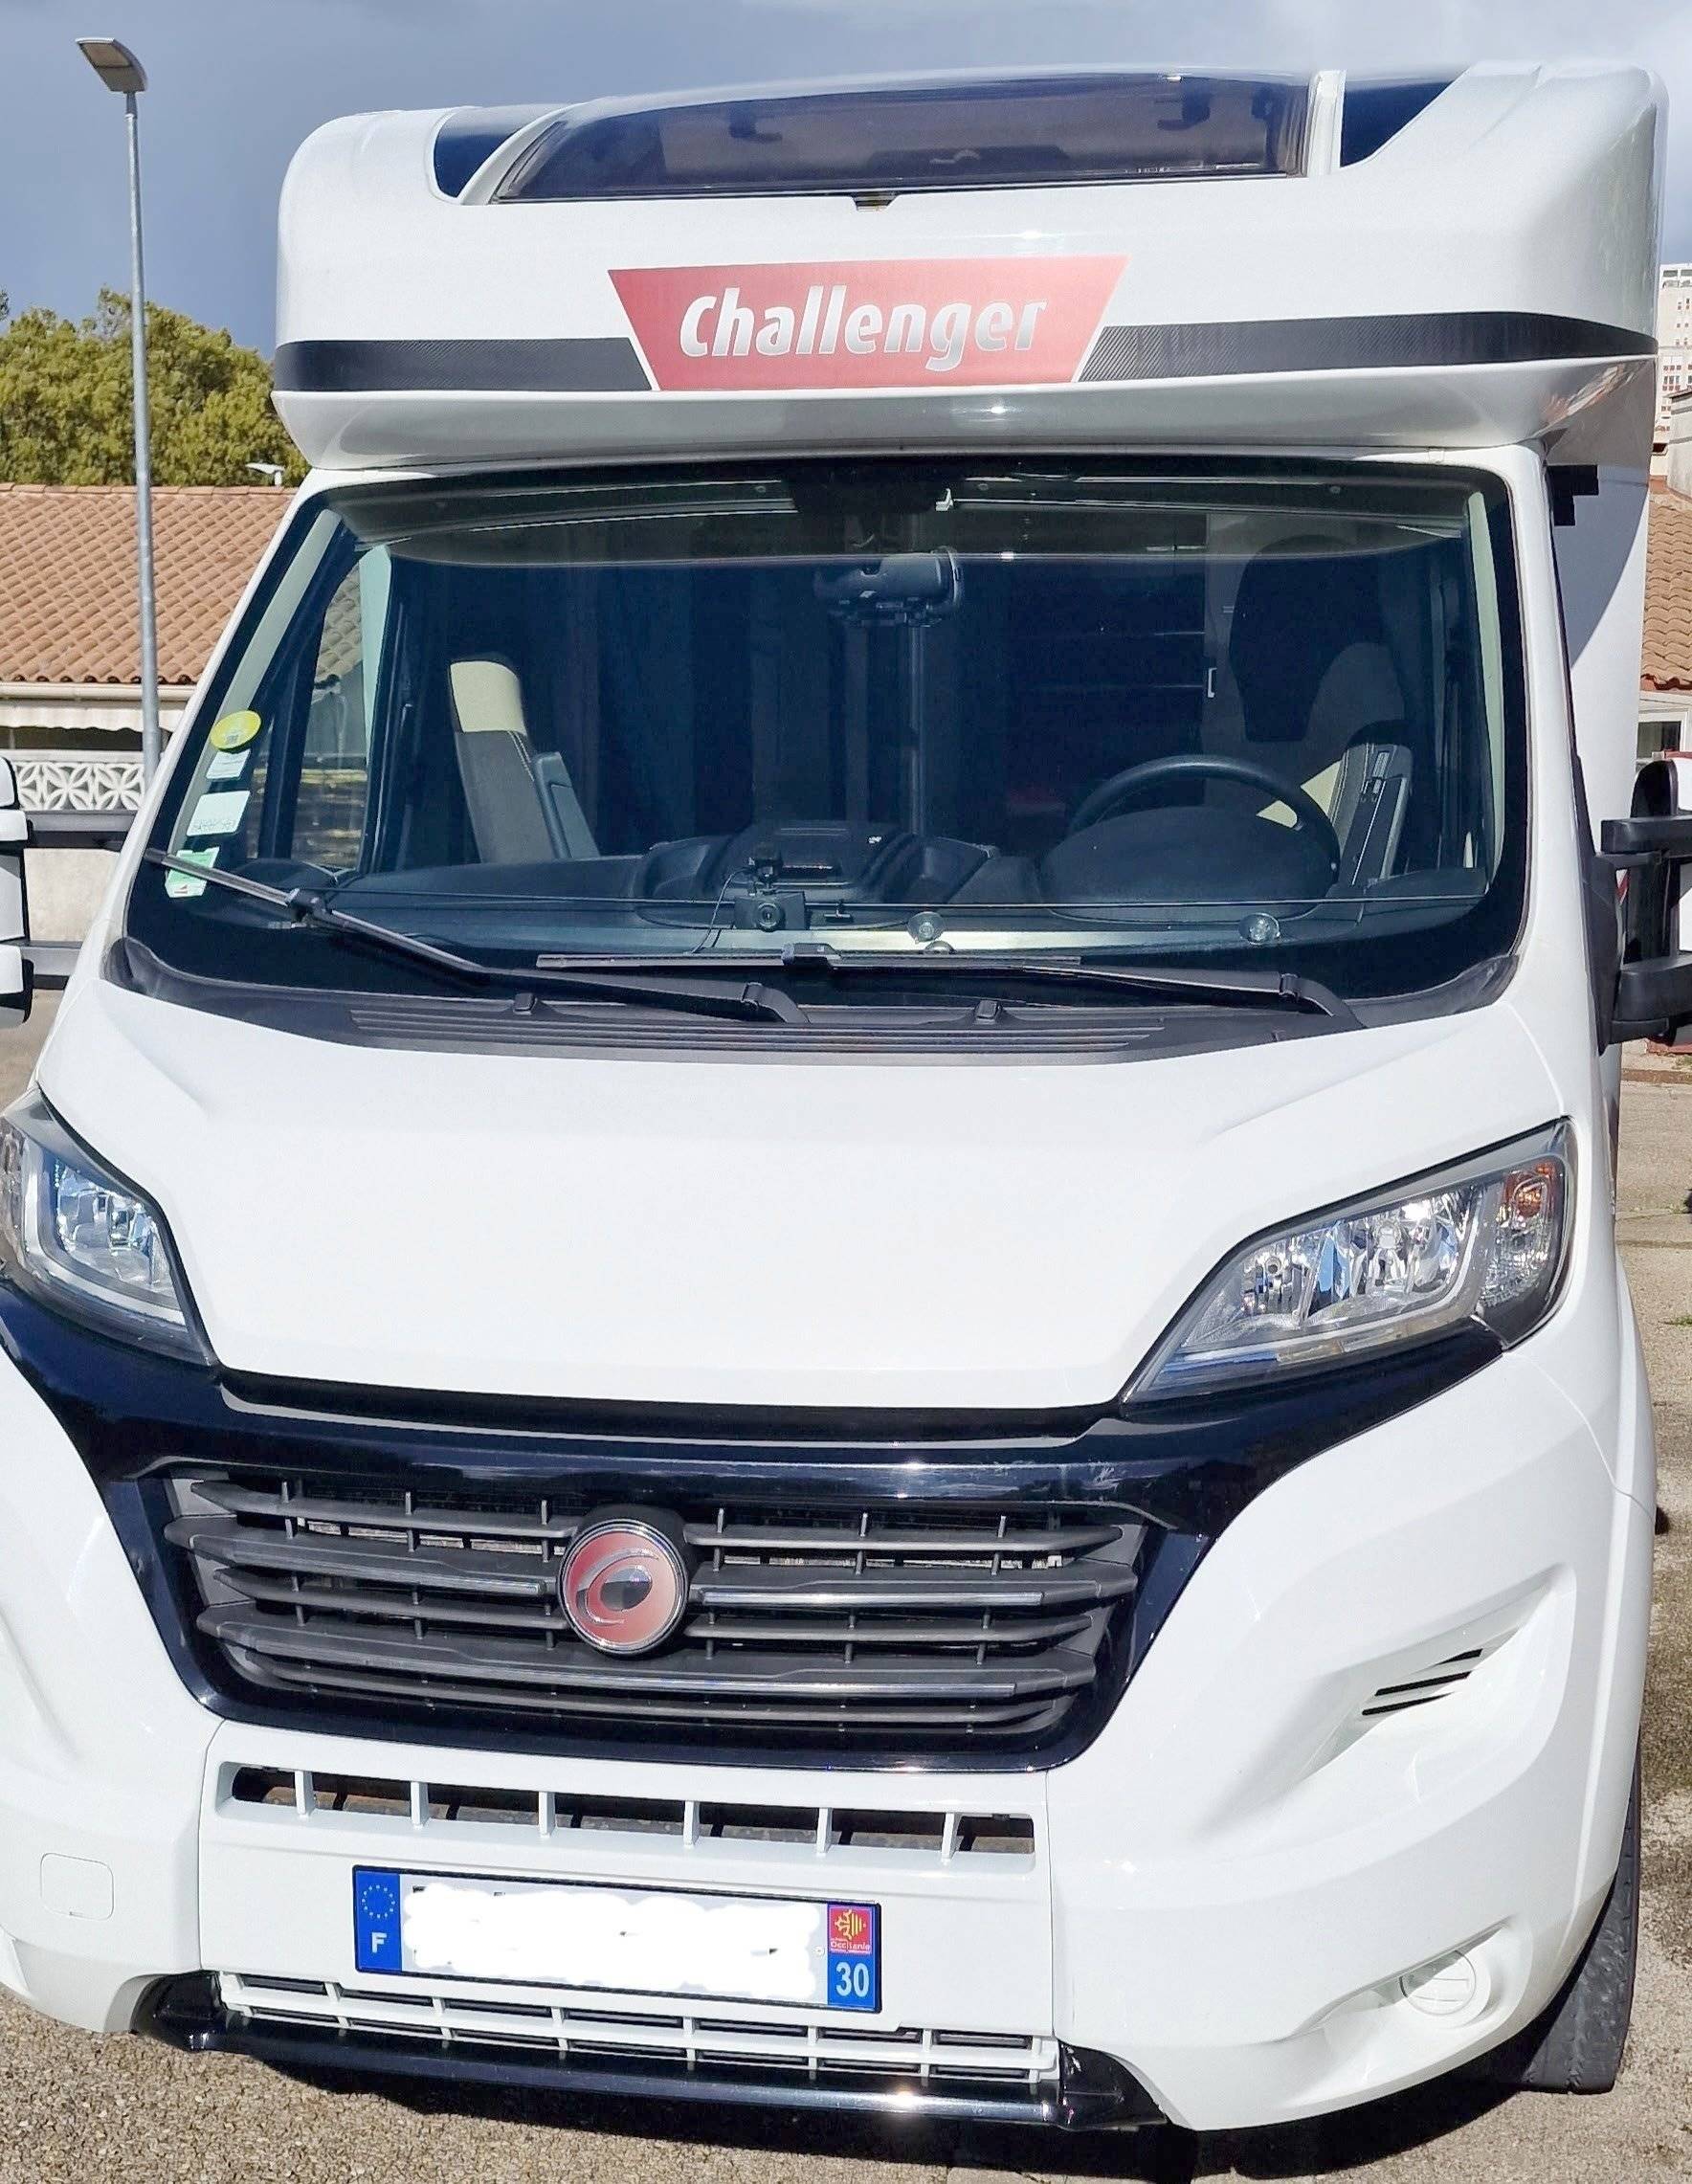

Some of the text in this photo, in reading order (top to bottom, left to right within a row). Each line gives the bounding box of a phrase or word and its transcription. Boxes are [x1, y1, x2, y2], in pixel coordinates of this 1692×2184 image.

[679, 285, 1048, 372] Challenger
[371, 1931, 388, 1953] F
[835, 1961, 870, 1997] 30
